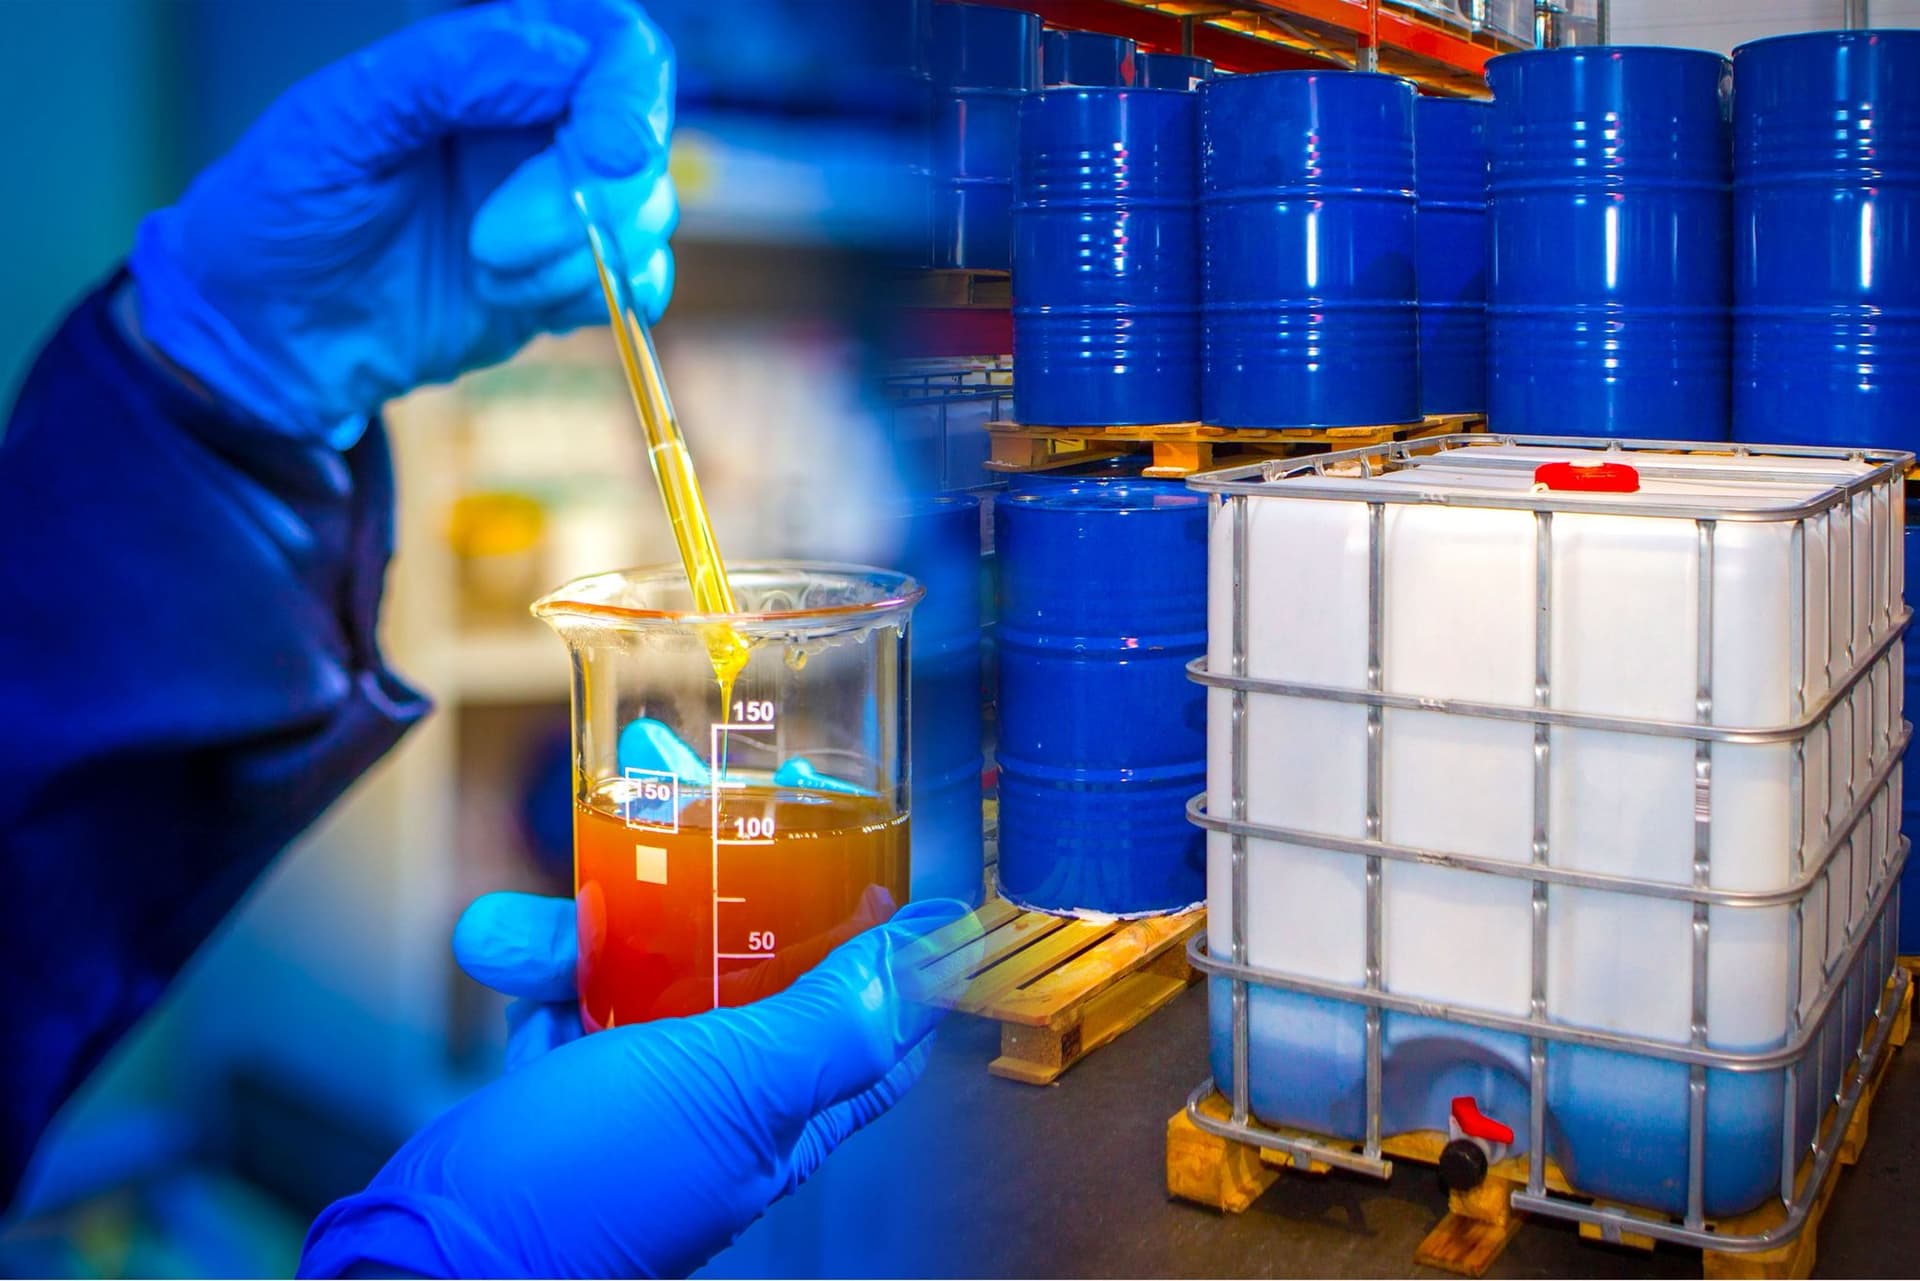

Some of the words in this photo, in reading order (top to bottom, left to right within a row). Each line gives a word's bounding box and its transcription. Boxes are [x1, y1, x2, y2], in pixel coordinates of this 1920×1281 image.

[733, 700, 774, 721] 150
[635, 781, 670, 801] 150
[734, 817, 775, 839] 100
[748, 931, 775, 950] 50
